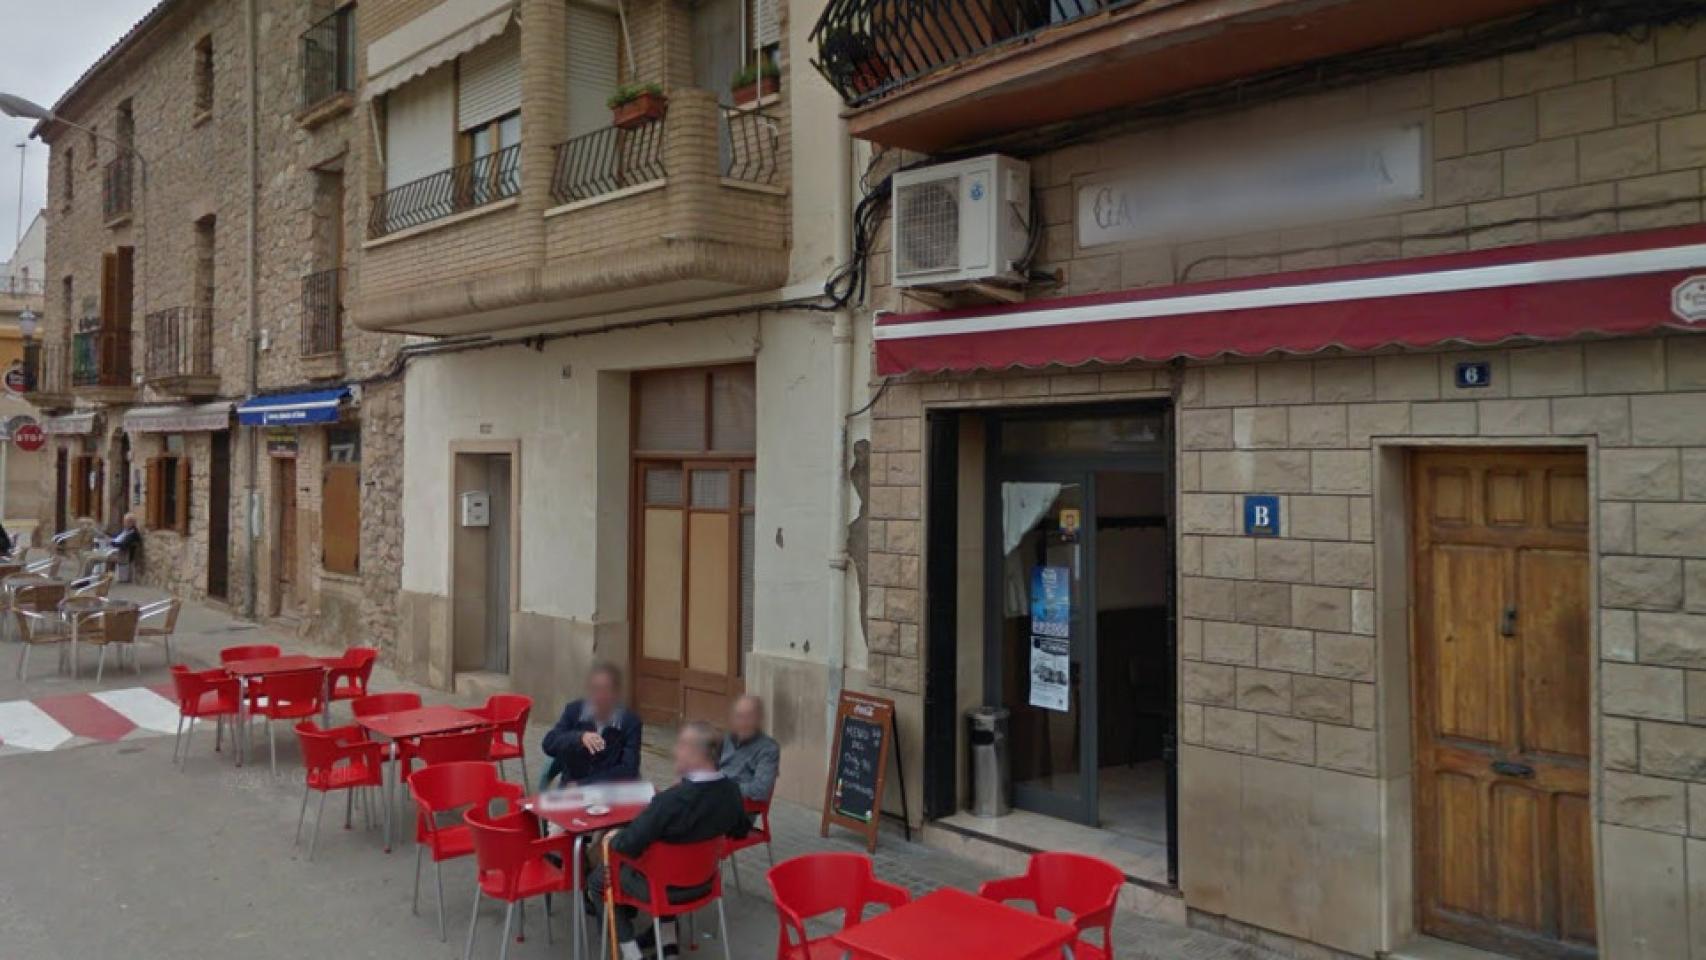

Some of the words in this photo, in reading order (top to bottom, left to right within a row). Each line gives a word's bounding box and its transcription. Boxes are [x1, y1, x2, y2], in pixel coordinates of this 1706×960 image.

[1465, 367, 1478, 384] 6
[16, 433, 44, 442] STOP
[1255, 506, 1269, 526] B
